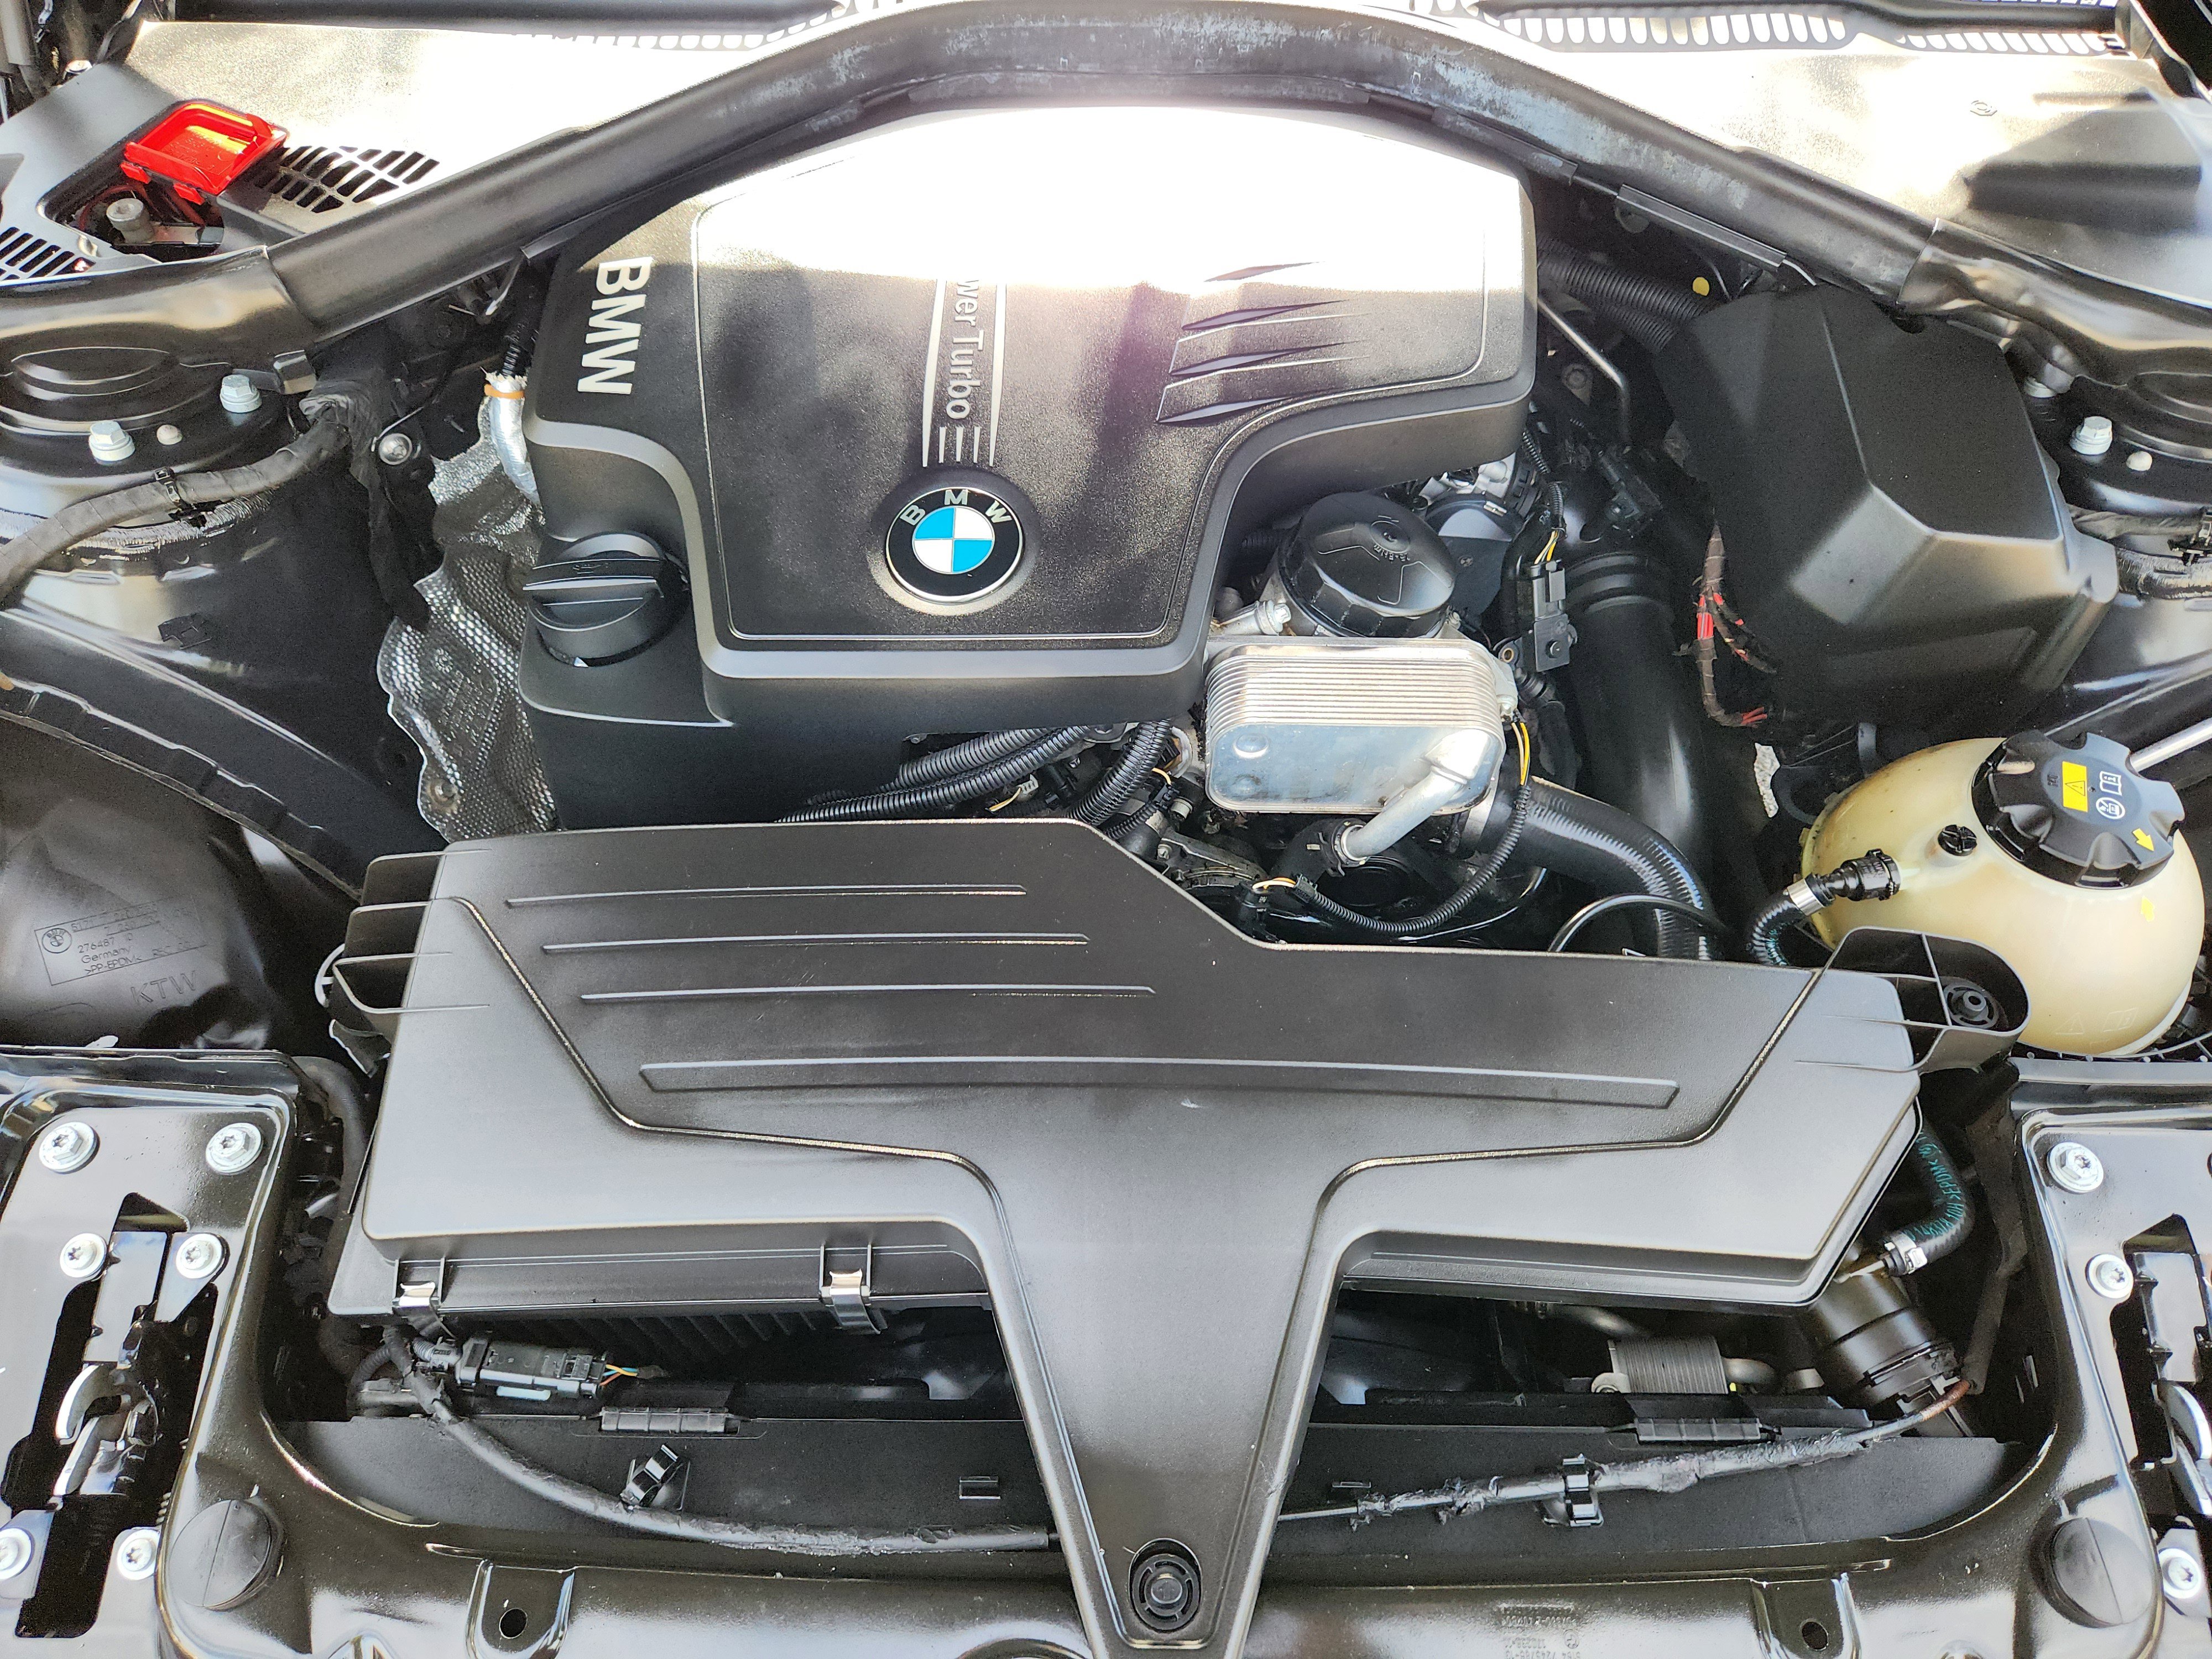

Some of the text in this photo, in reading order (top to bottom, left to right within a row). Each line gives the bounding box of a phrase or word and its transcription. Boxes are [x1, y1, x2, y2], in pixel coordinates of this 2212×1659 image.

[577, 256, 654, 395] BMW
[946, 330, 984, 419] Turbo
[900, 489, 1013, 526] BMW
[77, 937, 115, 954] 276487
[81, 946, 132, 964] Germany
[131, 971, 196, 1004] KTW
